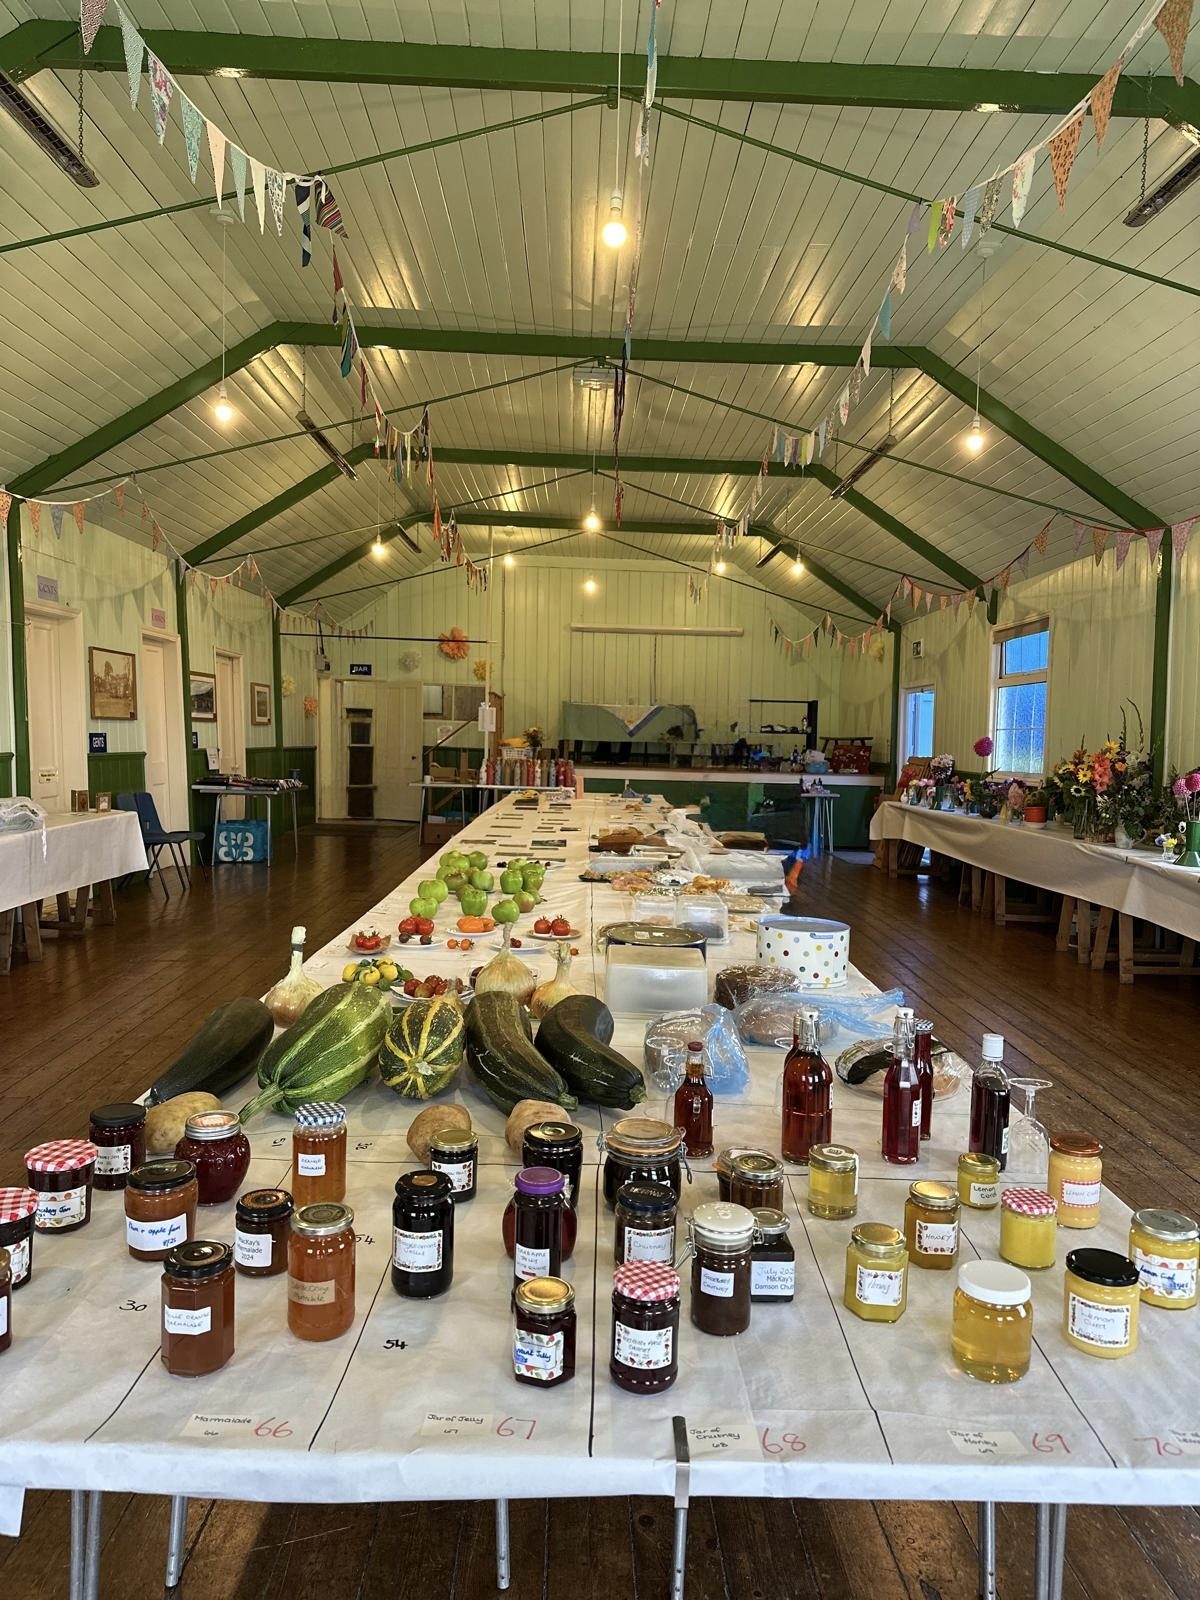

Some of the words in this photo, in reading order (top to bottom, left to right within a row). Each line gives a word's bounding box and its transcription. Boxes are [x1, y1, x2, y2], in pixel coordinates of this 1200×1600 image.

[93, 737, 105, 747] GENTS
[119, 1300, 147, 1311] 30
[383, 1339, 408, 1350] 54
[194, 1415, 252, 1424] Marmalade
[458, 1416, 484, 1424] Jelly
[255, 1417, 293, 1438] 66
[496, 1416, 537, 1440] 67
[696, 1433, 741, 1441] Chutney
[762, 1428, 806, 1454] 68
[1032, 1433, 1071, 1454] 69
[1133, 1437, 1184, 1456] 70
